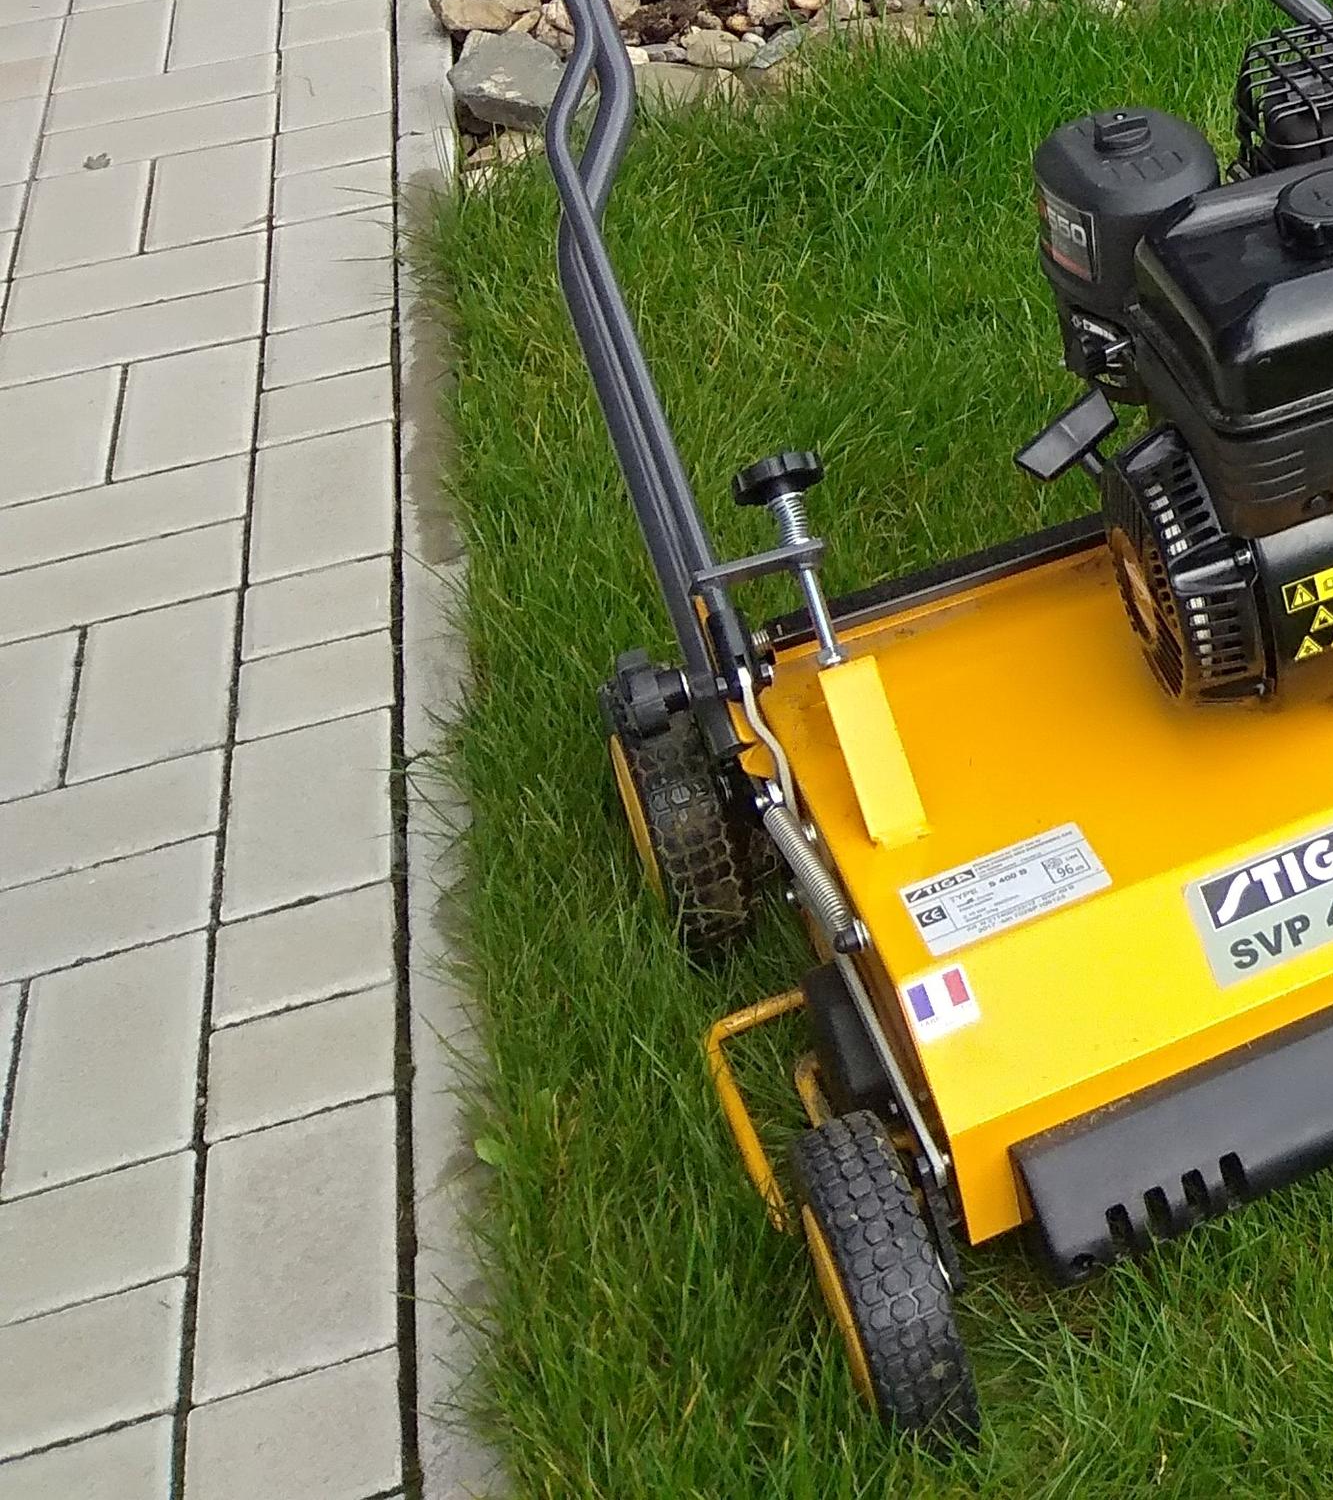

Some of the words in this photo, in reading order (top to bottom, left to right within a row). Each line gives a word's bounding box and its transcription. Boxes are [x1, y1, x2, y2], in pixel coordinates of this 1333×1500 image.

[1056, 863, 1074, 878] 96
[907, 871, 974, 902] STIGA
[950, 888, 978, 902] TYPE
[1230, 913, 1310, 970] SVP
